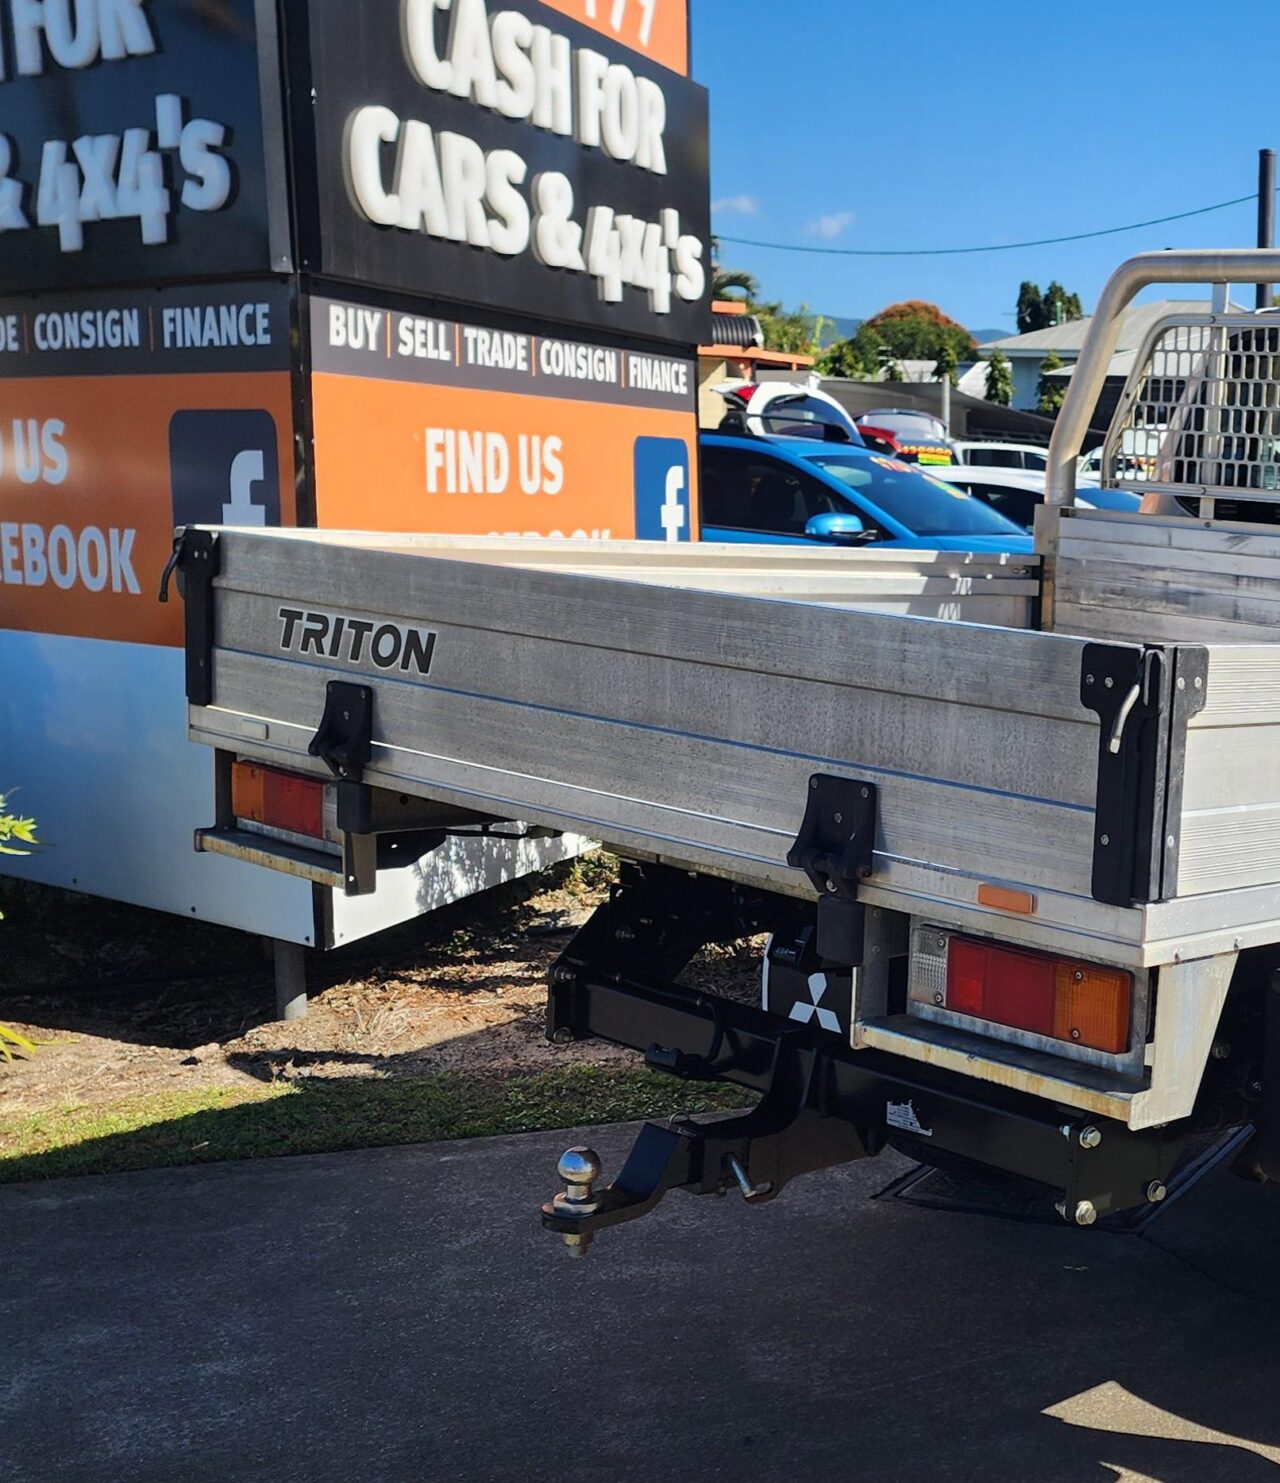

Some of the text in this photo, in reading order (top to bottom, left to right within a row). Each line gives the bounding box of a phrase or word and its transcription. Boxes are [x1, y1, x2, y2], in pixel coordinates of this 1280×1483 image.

[404, 0, 667, 175] CASH FOR
[345, 105, 529, 255] CARS
[532, 171, 586, 271] &
[34, 307, 140, 350] CONSIGN
[162, 303, 271, 349] FINANCE
[328, 303, 688, 395] BUY SELL TRADE CONSIGN FINANCE
[12, 417, 69, 485] US
[425, 427, 564, 495] FIND US
[0, 521, 142, 595] EBOOK
[278, 606, 438, 677] TRITON
